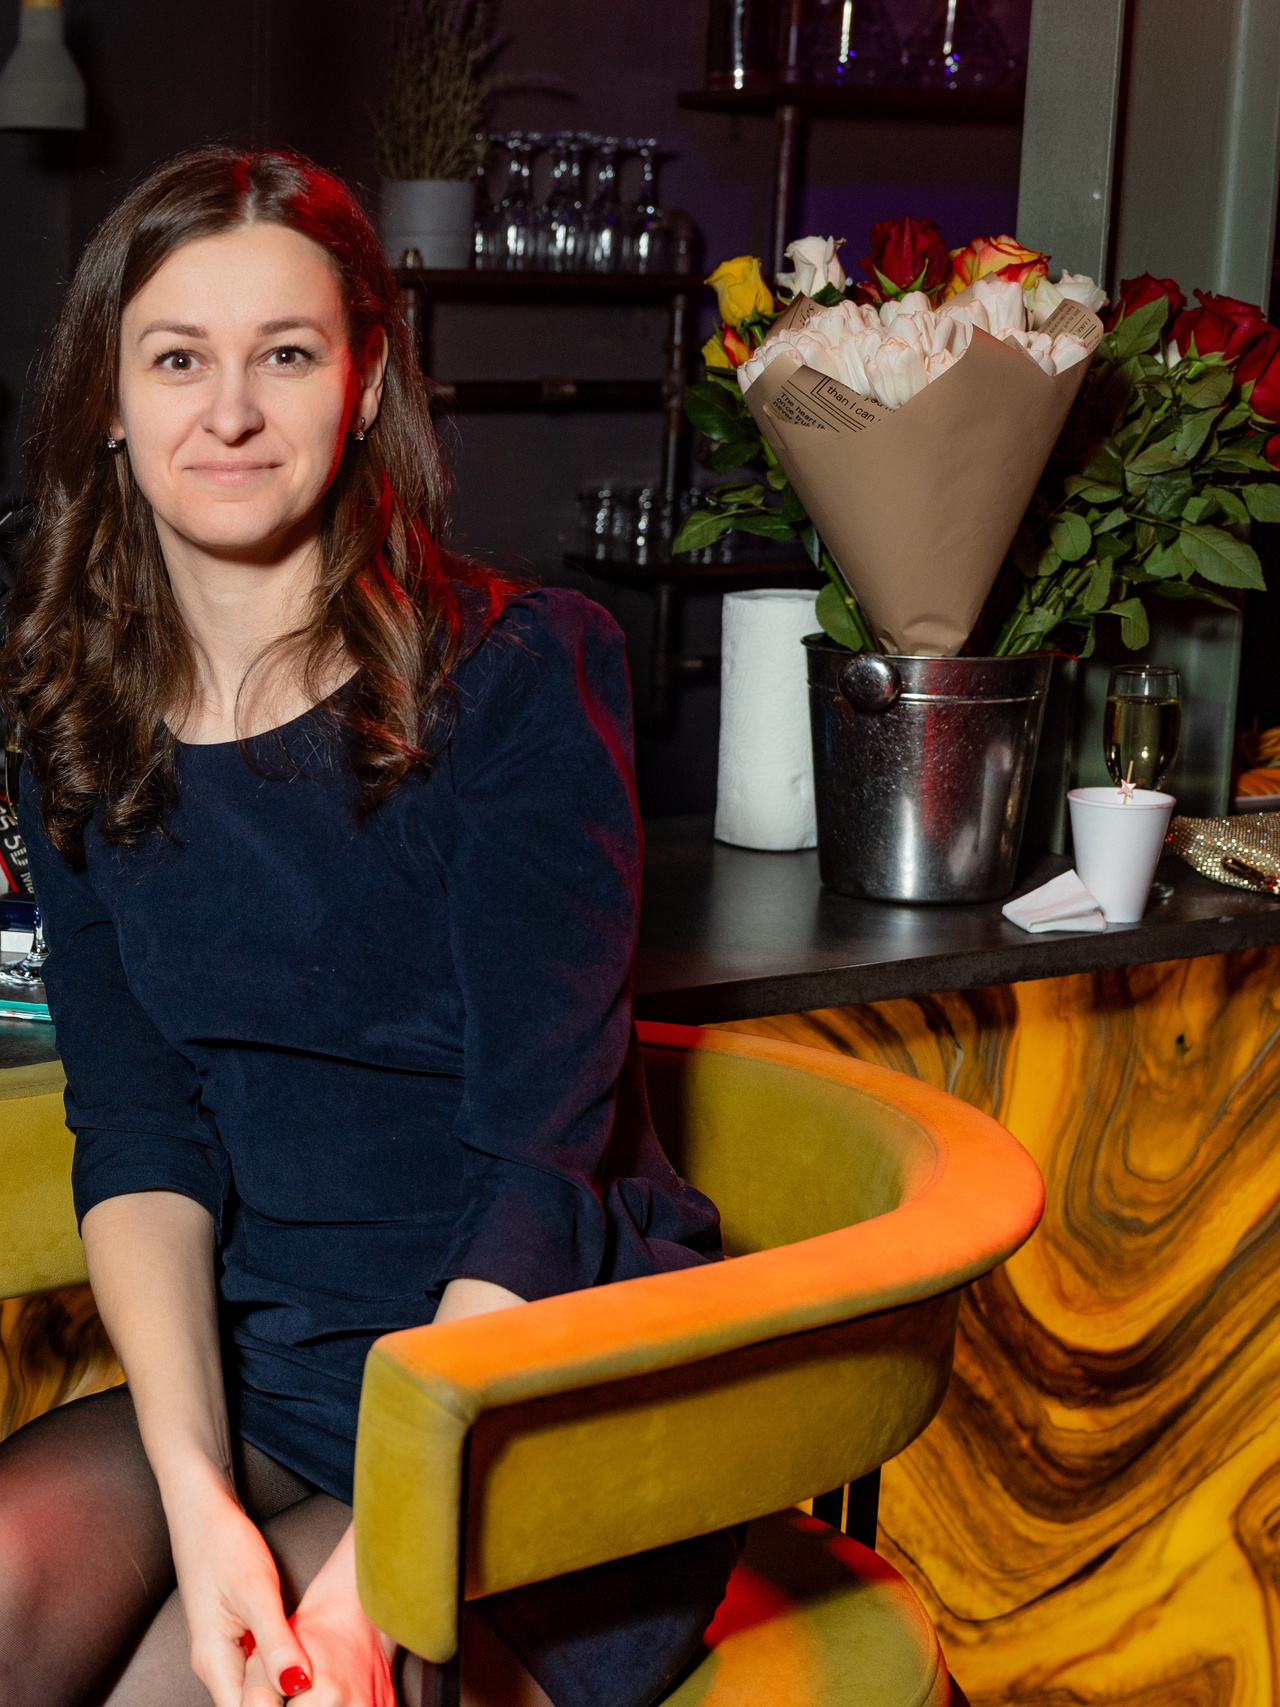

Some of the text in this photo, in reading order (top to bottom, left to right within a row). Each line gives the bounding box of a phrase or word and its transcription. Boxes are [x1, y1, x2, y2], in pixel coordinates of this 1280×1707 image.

[773, 401, 793, 420] never
[776, 398, 794, 415] once
[781, 392, 795, 407] The
[795, 406, 817, 425] heart
[827, 386, 849, 406] than
[849, 402, 857, 410] I
[855, 407, 875, 422] can
[3, 834, 29, 866] 5D
